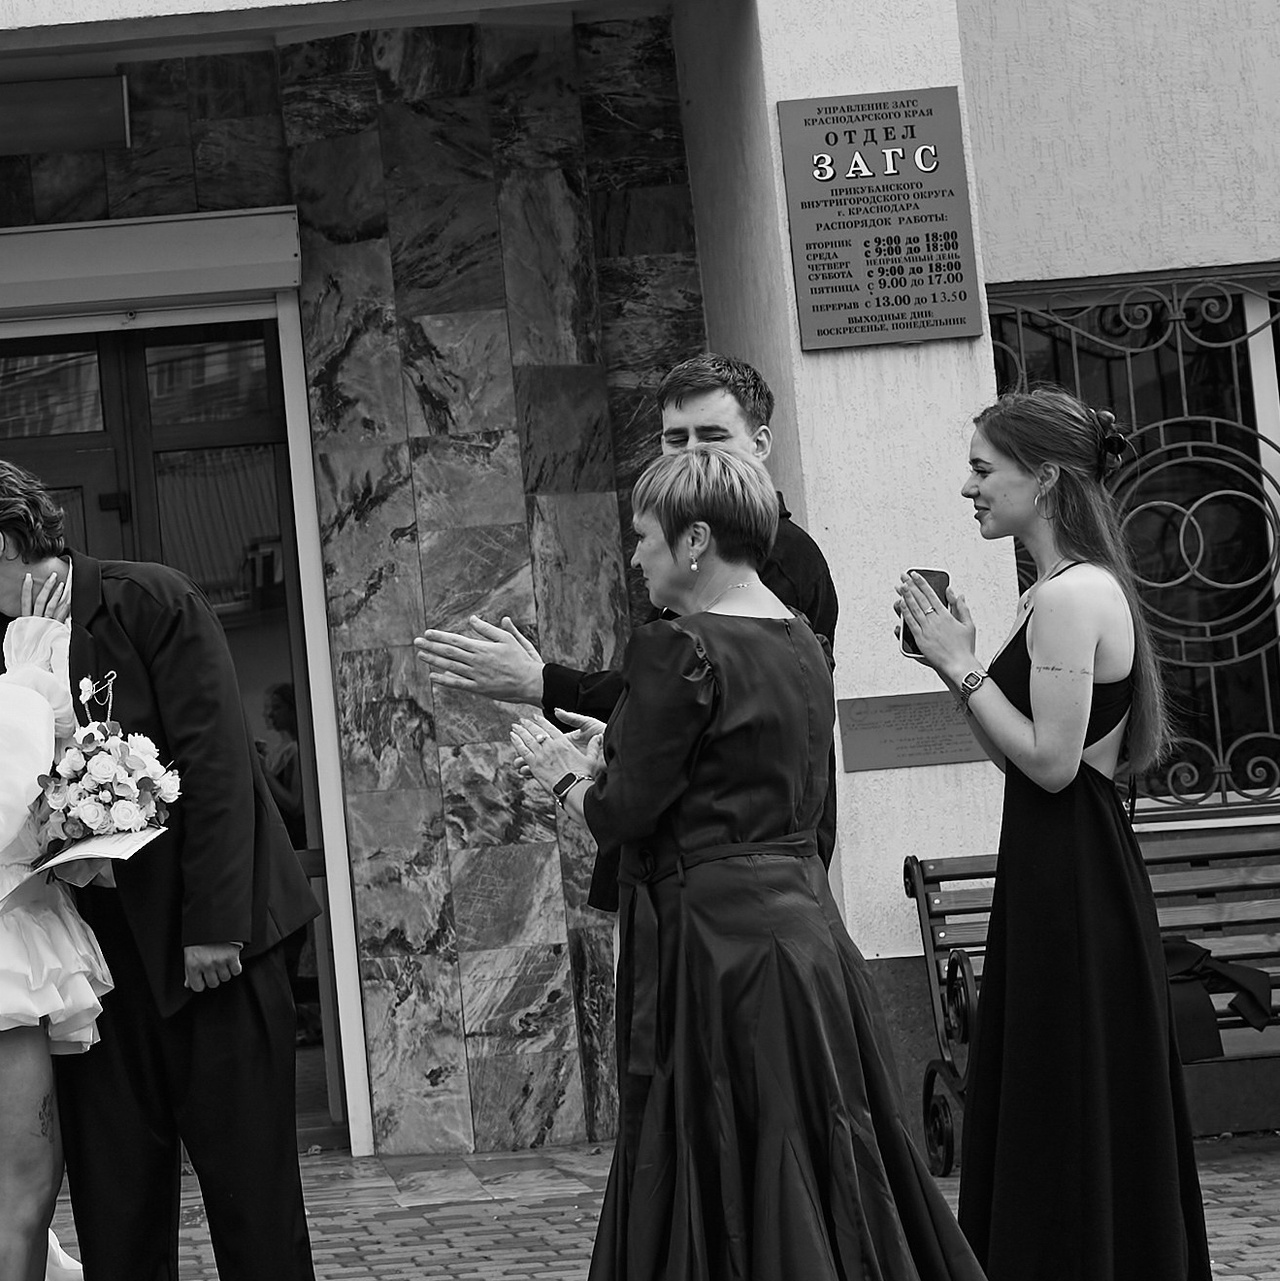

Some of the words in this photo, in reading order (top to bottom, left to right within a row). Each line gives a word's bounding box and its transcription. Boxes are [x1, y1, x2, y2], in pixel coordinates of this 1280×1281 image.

[817, 102, 889, 115] УПРАВЛЕНИЕ
[892, 100, 918, 109] ЗАГС
[804, 112, 901, 126] КРАСНОДАРСКОГО
[904, 109, 933, 118] КРАЯ
[825, 124, 916, 146] ОТДЕЛ
[813, 145, 939, 181] ЗАГС
[831, 182, 923, 196] ПРИКУБАНСКОГО
[801, 193, 910, 209] ВНУТРИГОРОДСКОГО
[913, 189, 955, 199] ОКРУГА
[848, 203, 920, 216] КРАСНОДАРА
[816, 218, 891, 231] РАСПОРЯДОК
[898, 214, 948, 224] РАБОТЫ:
[805, 240, 852, 250] ВТОРНИК
[874, 235, 901, 246] 9:00
[905, 236, 919, 245] до
[925, 231, 958, 243] 18:00
[806, 252, 838, 261] СРЕДА
[875, 245, 902, 257] 9:00
[906, 246, 920, 255] до
[926, 241, 958, 252] 18:00
[807, 261, 850, 271] ЧЕТВЕРГ
[936, 253, 960, 261] ДЕНЬ
[808, 271, 853, 281] СУББОТА
[878, 265, 904, 277] 9:00
[908, 266, 923, 275] до
[928, 261, 961, 273] 18:00
[810, 284, 860, 295] ПЯТНИЦА
[878, 277, 907, 289] 9.00
[911, 278, 924, 287] до
[928, 272, 963, 285] 17.00
[812, 302, 859, 312] ПЕРЕРЫВ
[875, 295, 911, 307] 13.00
[914, 297, 927, 306] до
[931, 291, 967, 303] 13.50
[817, 324, 888, 336] ВОСКРЕСЕНЬЕ,
[892, 317, 966, 331] ПОНЕДЕЛЬНИК
[848, 313, 907, 324] ВЫХОДНЫЕ
